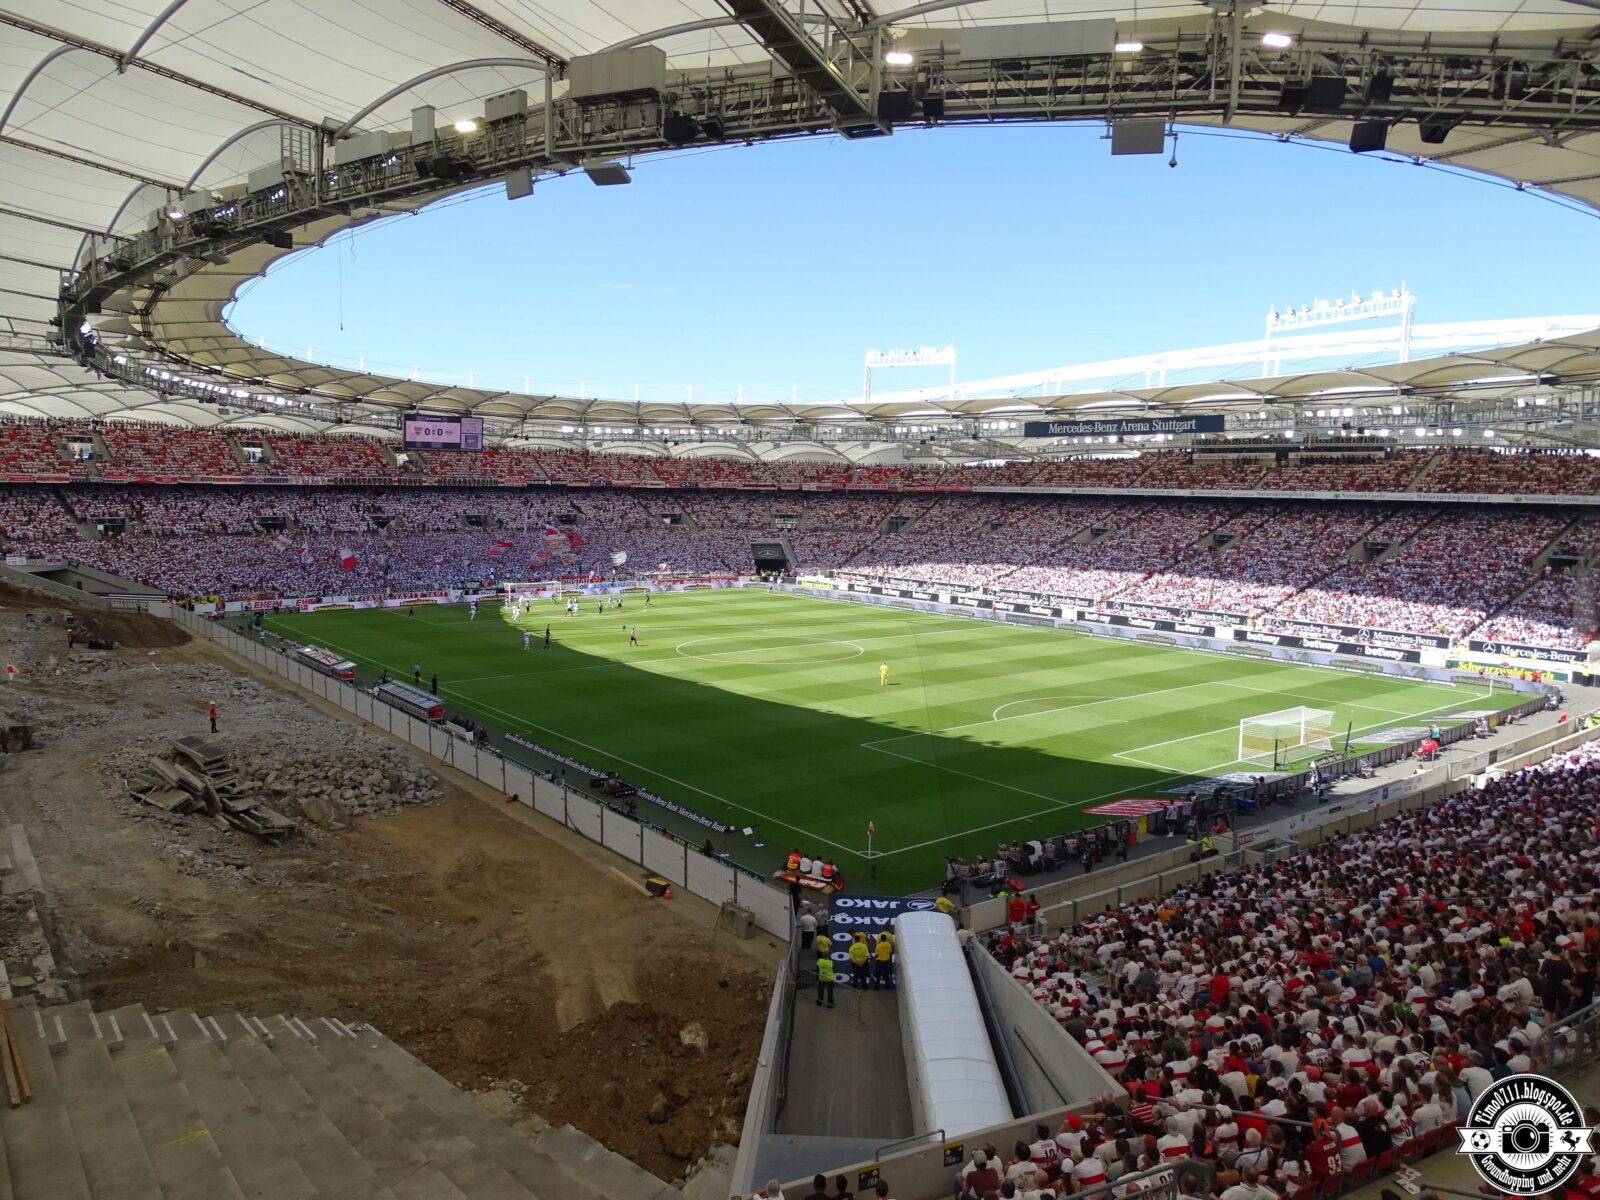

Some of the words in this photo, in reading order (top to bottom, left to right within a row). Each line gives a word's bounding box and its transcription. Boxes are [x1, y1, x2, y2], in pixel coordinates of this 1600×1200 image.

[1048, 420, 1118, 434] Mercedes-Benz
[1120, 420, 1150, 432] Arena
[1152, 418, 1196, 433] Stuttgart
[1416, 494, 1475, 502] Natursprünglich
[254, 600, 283, 609] EHEIM
[1190, 611, 1240, 624] Mercedes-Benz
[1285, 622, 1342, 636] Mercedes-Benz
[1246, 632, 1280, 646] betway
[1302, 638, 1339, 653] betway
[1373, 631, 1438, 646] Mercedes-Benz
[1364, 645, 1404, 660] betway
[1500, 645, 1576, 662] Mercedes-Benz
[637, 788, 668, 808] Mercedes-Benz
[666, 801, 679, 812] Bank
[678, 806, 712, 827] Mercedes-Benz
[712, 821, 726, 832] Bank
[836, 898, 900, 908] JAKO
